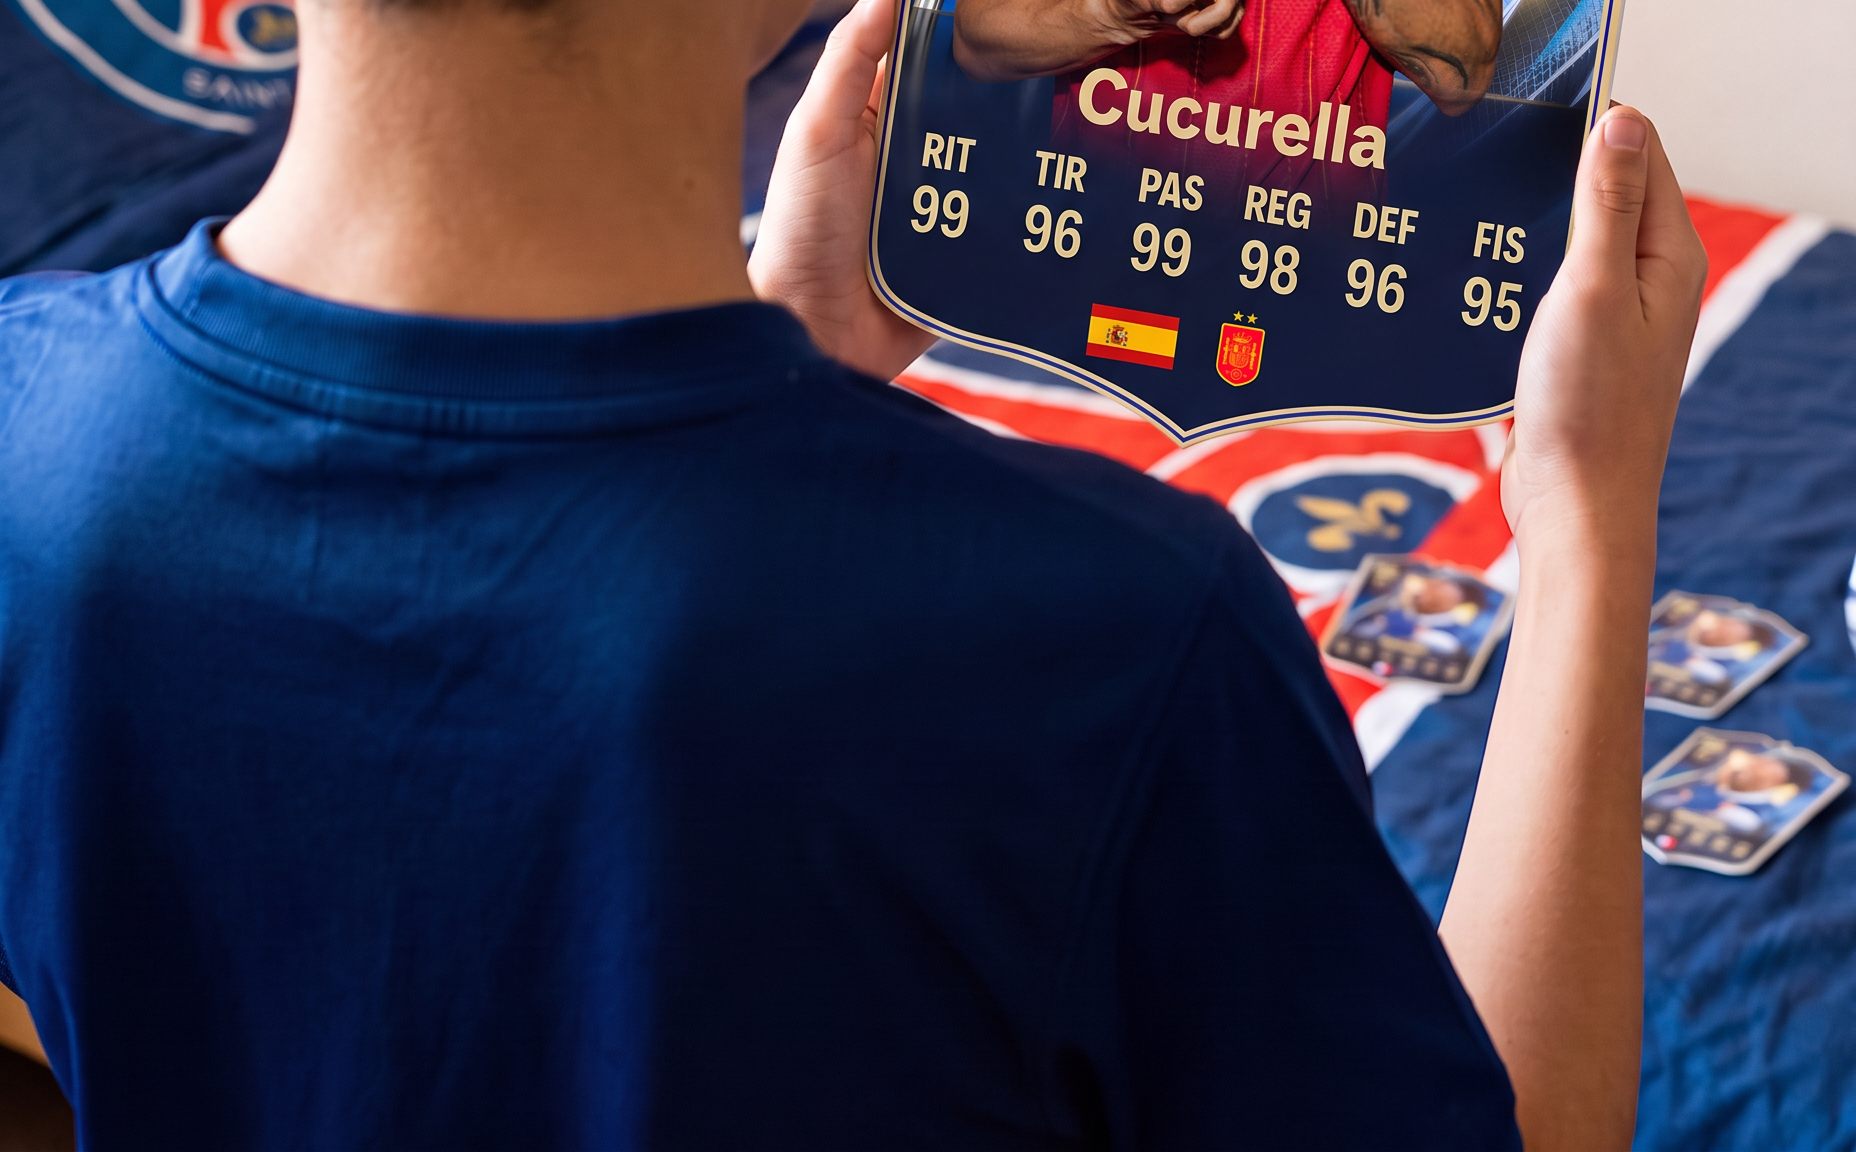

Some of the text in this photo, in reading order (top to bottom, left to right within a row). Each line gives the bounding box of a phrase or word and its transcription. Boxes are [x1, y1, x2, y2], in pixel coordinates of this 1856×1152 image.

[1078, 67, 1387, 171] Cucurella
[910, 184, 1524, 332] 99 96 99 98 96 95
[921, 132, 1527, 265] RIT TIR PAS REG DEF FIS
